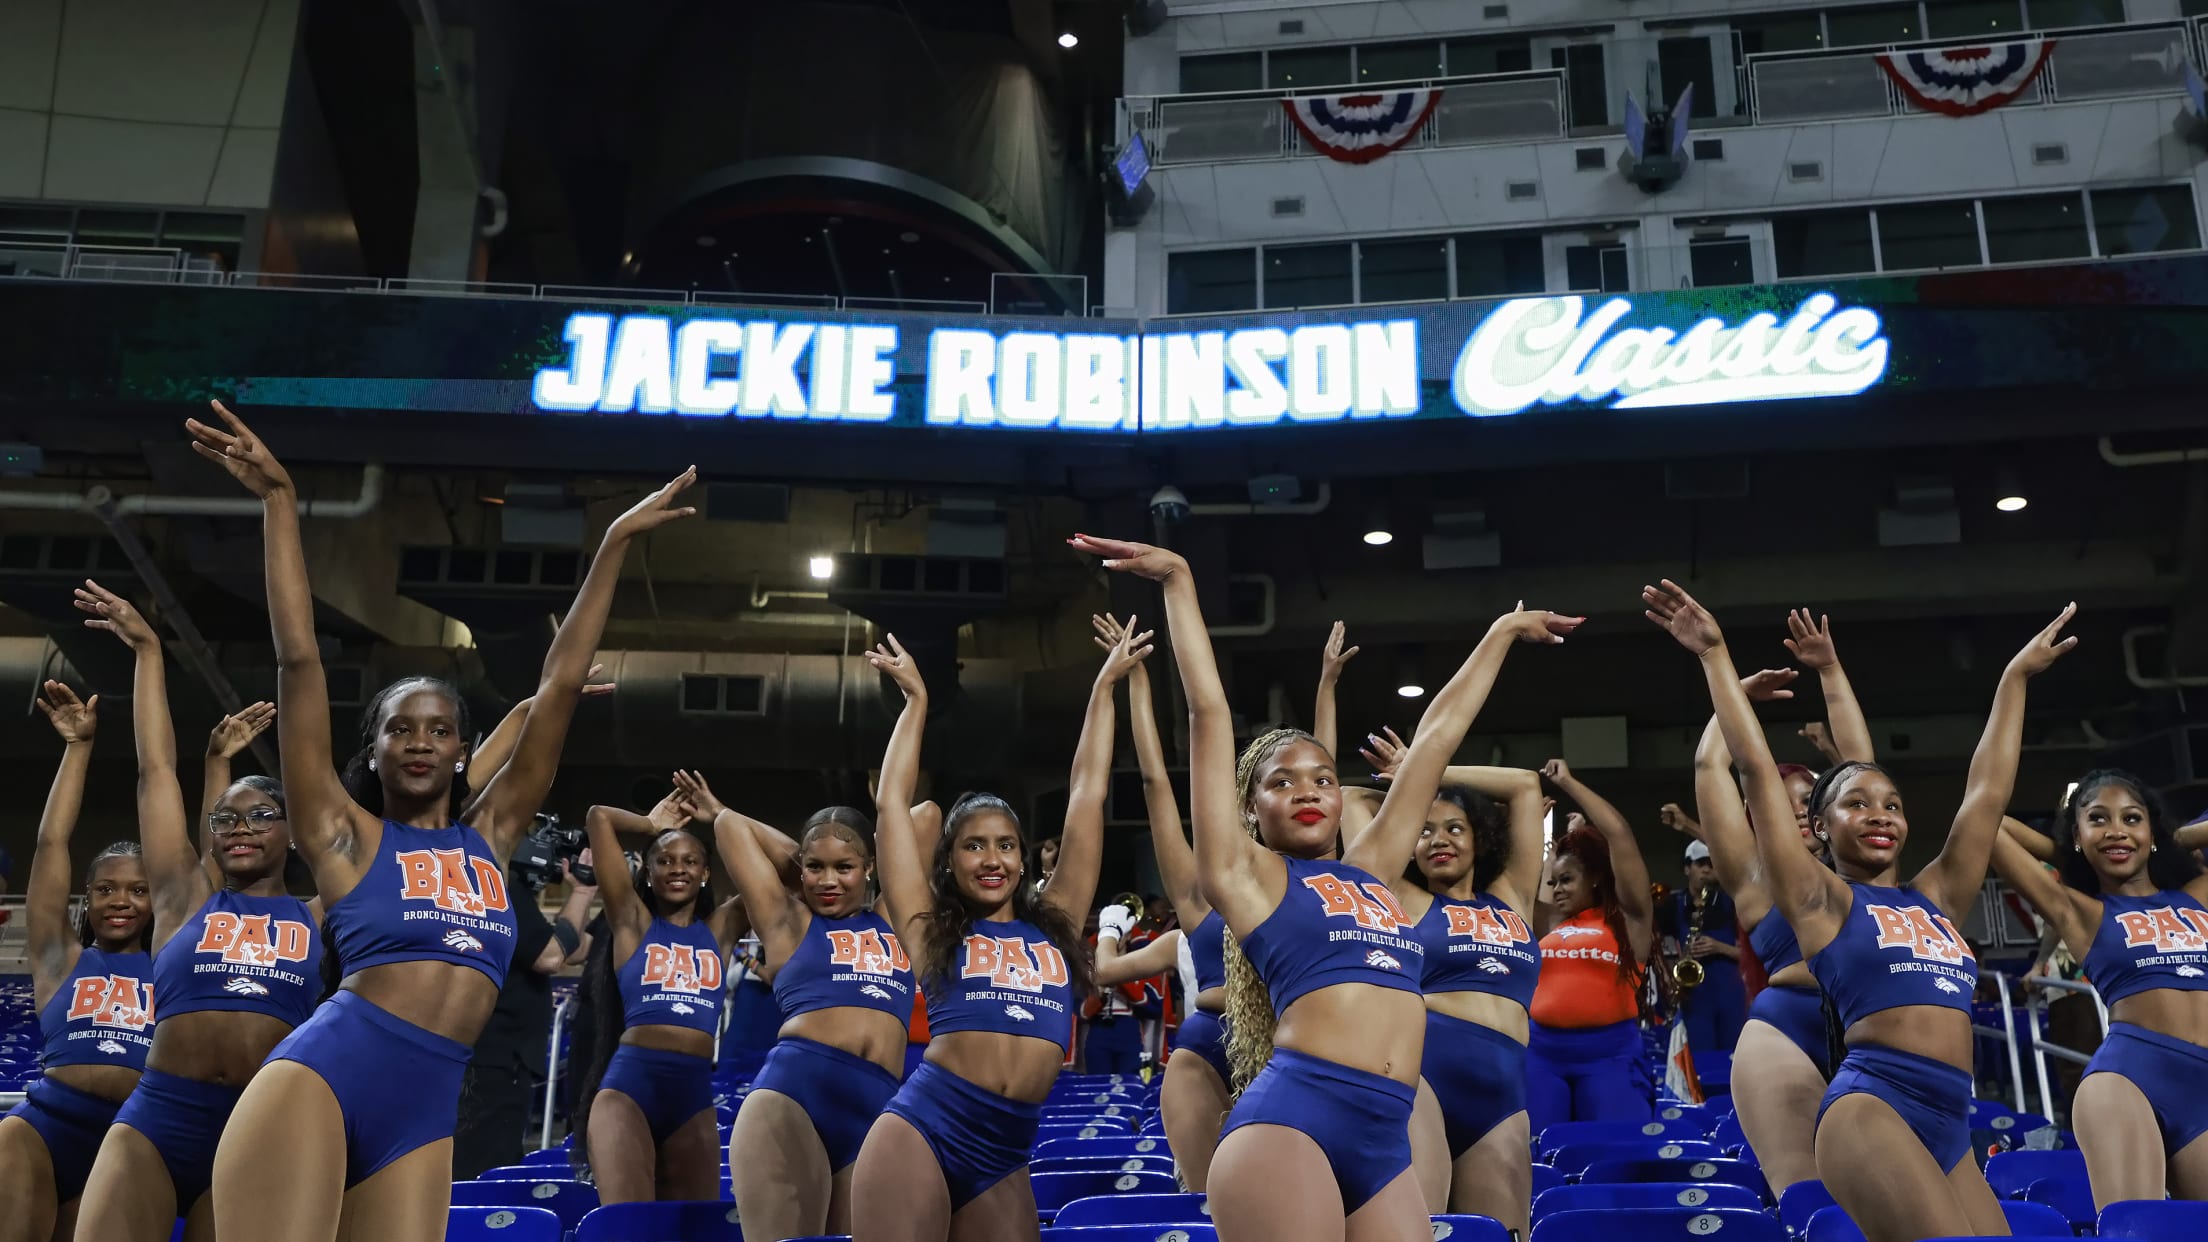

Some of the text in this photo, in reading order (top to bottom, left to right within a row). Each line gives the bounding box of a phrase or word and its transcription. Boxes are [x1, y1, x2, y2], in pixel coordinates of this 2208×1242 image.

[534, 291, 1890, 431] JACKIE ROBINSON Classic
[395, 847, 510, 918] BAD
[1301, 872, 1415, 935] BAD
[403, 910, 511, 937] BRONCO ATHLETIC DANCERS
[1441, 904, 1531, 947] BAD
[195, 911, 311, 967] BAD
[1329, 930, 1425, 956] BRONCO ATHLETIC DANCERS
[825, 927, 911, 976] BAD
[1448, 944, 1535, 964] BRONCO ATHLETIC DANCERS
[2135, 956, 2165, 968] BRONCO
[2166, 954, 2200, 964] ATHLETIC
[640, 942, 722, 995] BAD
[961, 933, 1069, 993] BAD
[1889, 962, 1922, 974] BRONCO
[1923, 963, 1957, 977] ATHLETIC
[194, 963, 304, 986] BRONCO ATHLETIC DANCERS
[832, 973, 908, 994] BRONCO ATHLETIC DANCERS
[665, 994, 695, 1004] ATHLETIC
[965, 991, 1064, 1013] BRONCO ATHLETIC DANCERS
[67, 1030, 97, 1041] BRONCO
[97, 1030, 134, 1041] ATHLETIC
[1667, 1147, 1673, 1156] 7
[1700, 1165, 1706, 1175] 7
[543, 1186, 548, 1195] 1
[1122, 1178, 1130, 1187] 4
[1688, 1191, 1697, 1202] 8
[496, 1214, 505, 1225] 3
[1700, 1218, 1709, 1231] 8
[1168, 1234, 1177, 1242] 6
[1432, 1225, 1439, 1235] 7
